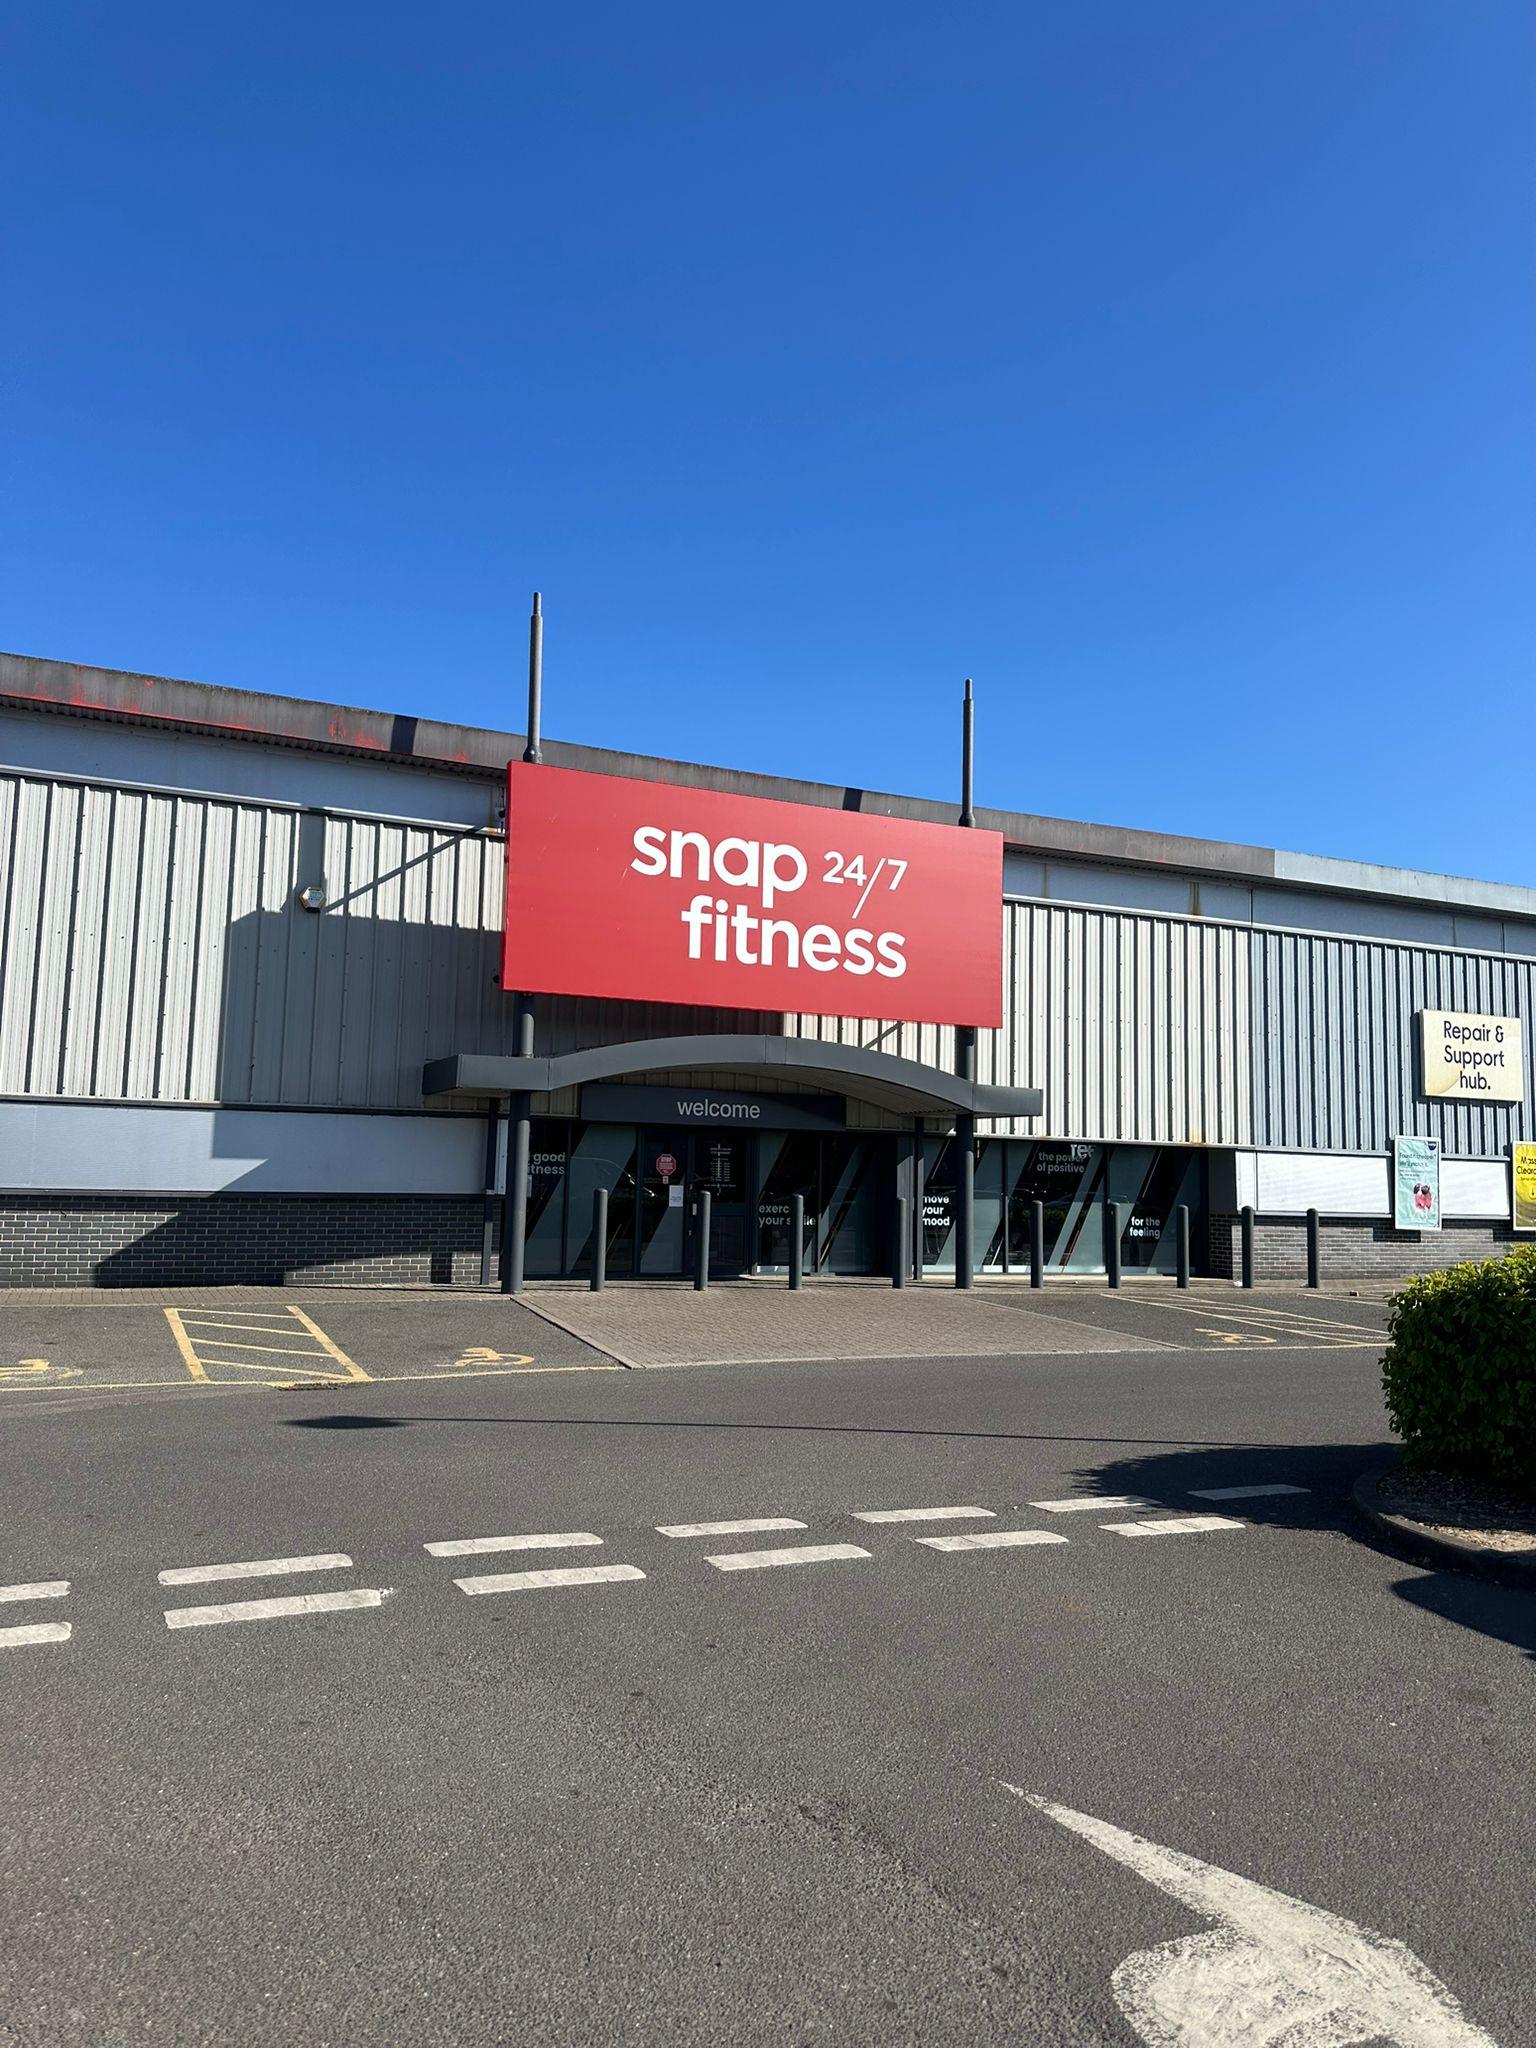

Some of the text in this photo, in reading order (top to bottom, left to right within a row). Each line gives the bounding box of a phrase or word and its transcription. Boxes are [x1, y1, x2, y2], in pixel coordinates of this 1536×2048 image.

[631, 827, 909, 919] snap 24/7
[681, 894, 908, 978] fitness
[1443, 1020, 1504, 1045] Repair &
[1443, 1045, 1505, 1070] Support
[1459, 1070, 1491, 1091] hub.
[677, 1098, 761, 1119] welcome
[533, 1152, 566, 1165] good
[1038, 1152, 1054, 1161] the
[527, 1162, 566, 1175] itness
[1036, 1162, 1085, 1175] of positive
[922, 1195, 950, 1204] move
[759, 1205, 790, 1214] exerc
[922, 1206, 945, 1217] your
[758, 1214, 817, 1229] your sile
[922, 1216, 951, 1226] mood
[1131, 1216, 1161, 1227] for the
[1129, 1226, 1161, 1240] feeling
